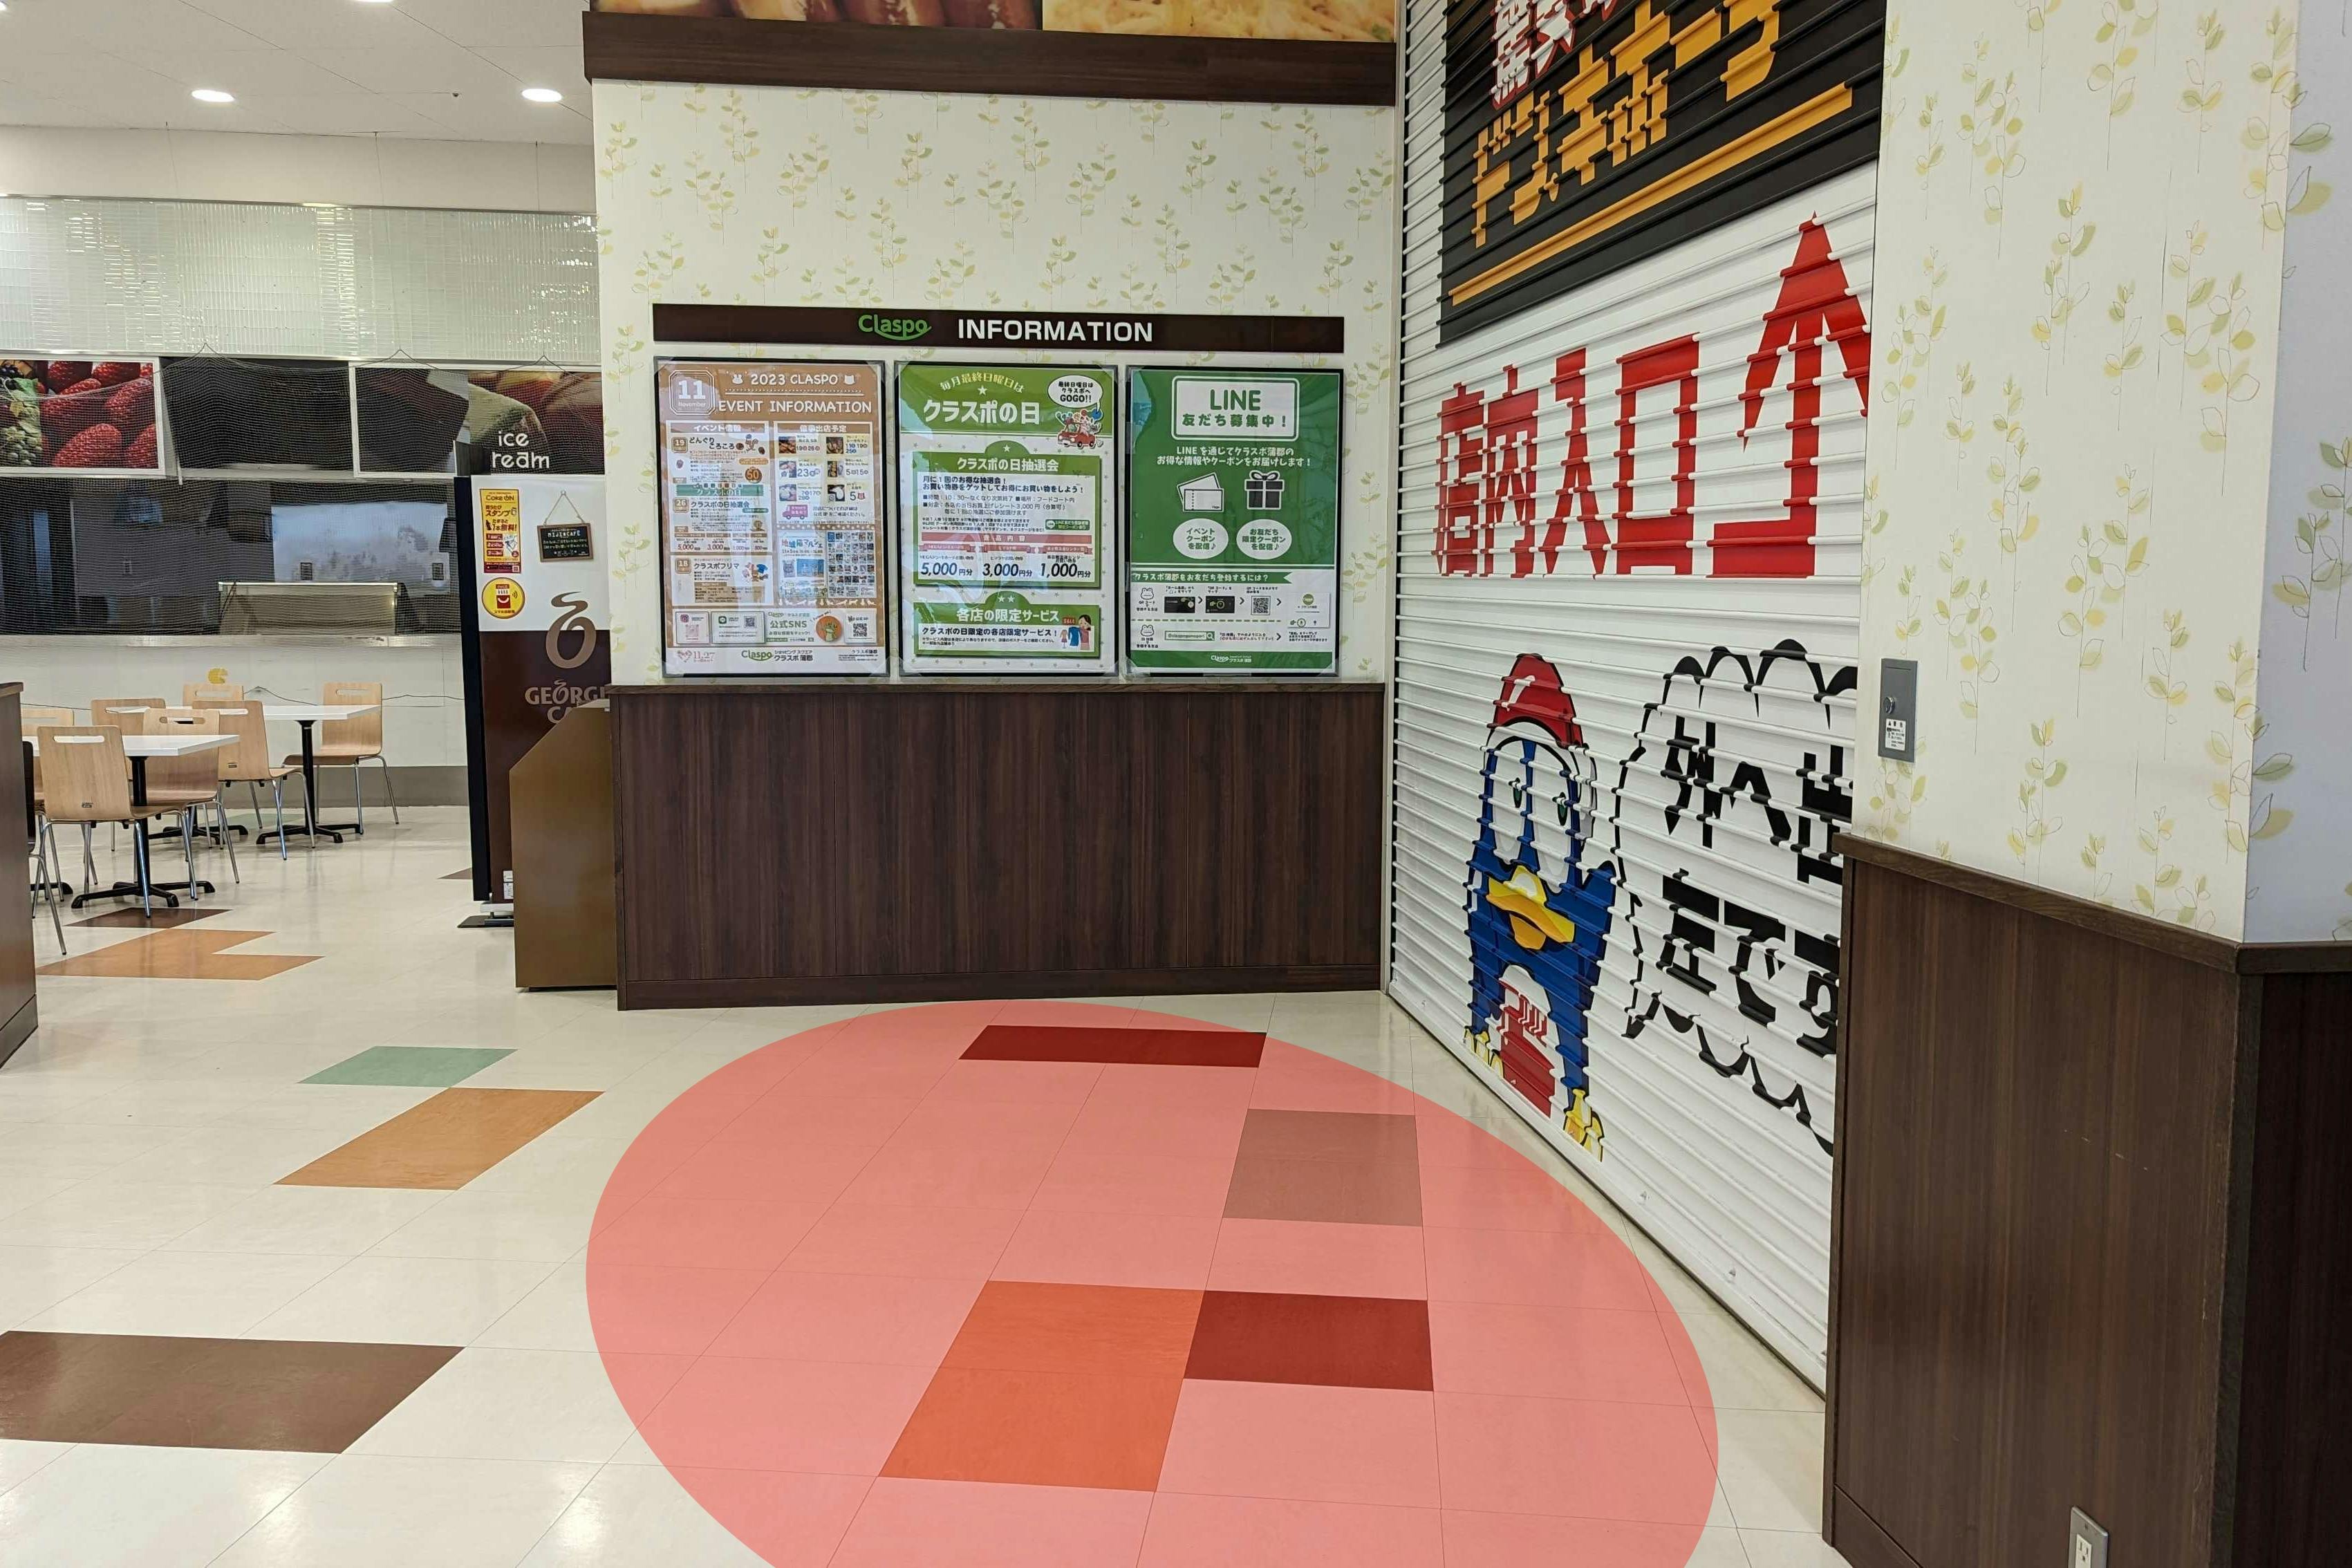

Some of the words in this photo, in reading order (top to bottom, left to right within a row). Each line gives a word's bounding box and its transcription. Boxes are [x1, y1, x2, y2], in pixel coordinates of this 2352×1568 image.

[858, 314, 932, 341] Claspo
[958, 319, 1152, 343] INFORMATION
[751, 374, 785, 385] 2023
[790, 375, 838, 385] CLASPO
[940, 371, 1025, 393] 毎月最終日曜日は
[678, 380, 706, 400] 11
[1060, 395, 1092, 403] GOGO!!
[1210, 389, 1262, 411] LINE
[719, 400, 763, 412] EVENT
[769, 401, 872, 413] INFORMATION
[923, 399, 1040, 425] クラスポの日
[498, 431, 530, 447] ice
[1432, 333, 1699, 579] 店内入口
[957, 457, 1059, 472] クラスポの日抽選会
[1186, 534, 1215, 543] クーポン
[1242, 535, 1286, 543] 限定クーポン
[1249, 528, 1279, 536] お友だち
[982, 563, 1033, 577] 3,000円分
[1040, 563, 1091, 578] 1,000円分
[956, 608, 1059, 622] 各店の限定サービス
[769, 620, 808, 628] 公式SNS
[741, 650, 774, 661] Claspo
